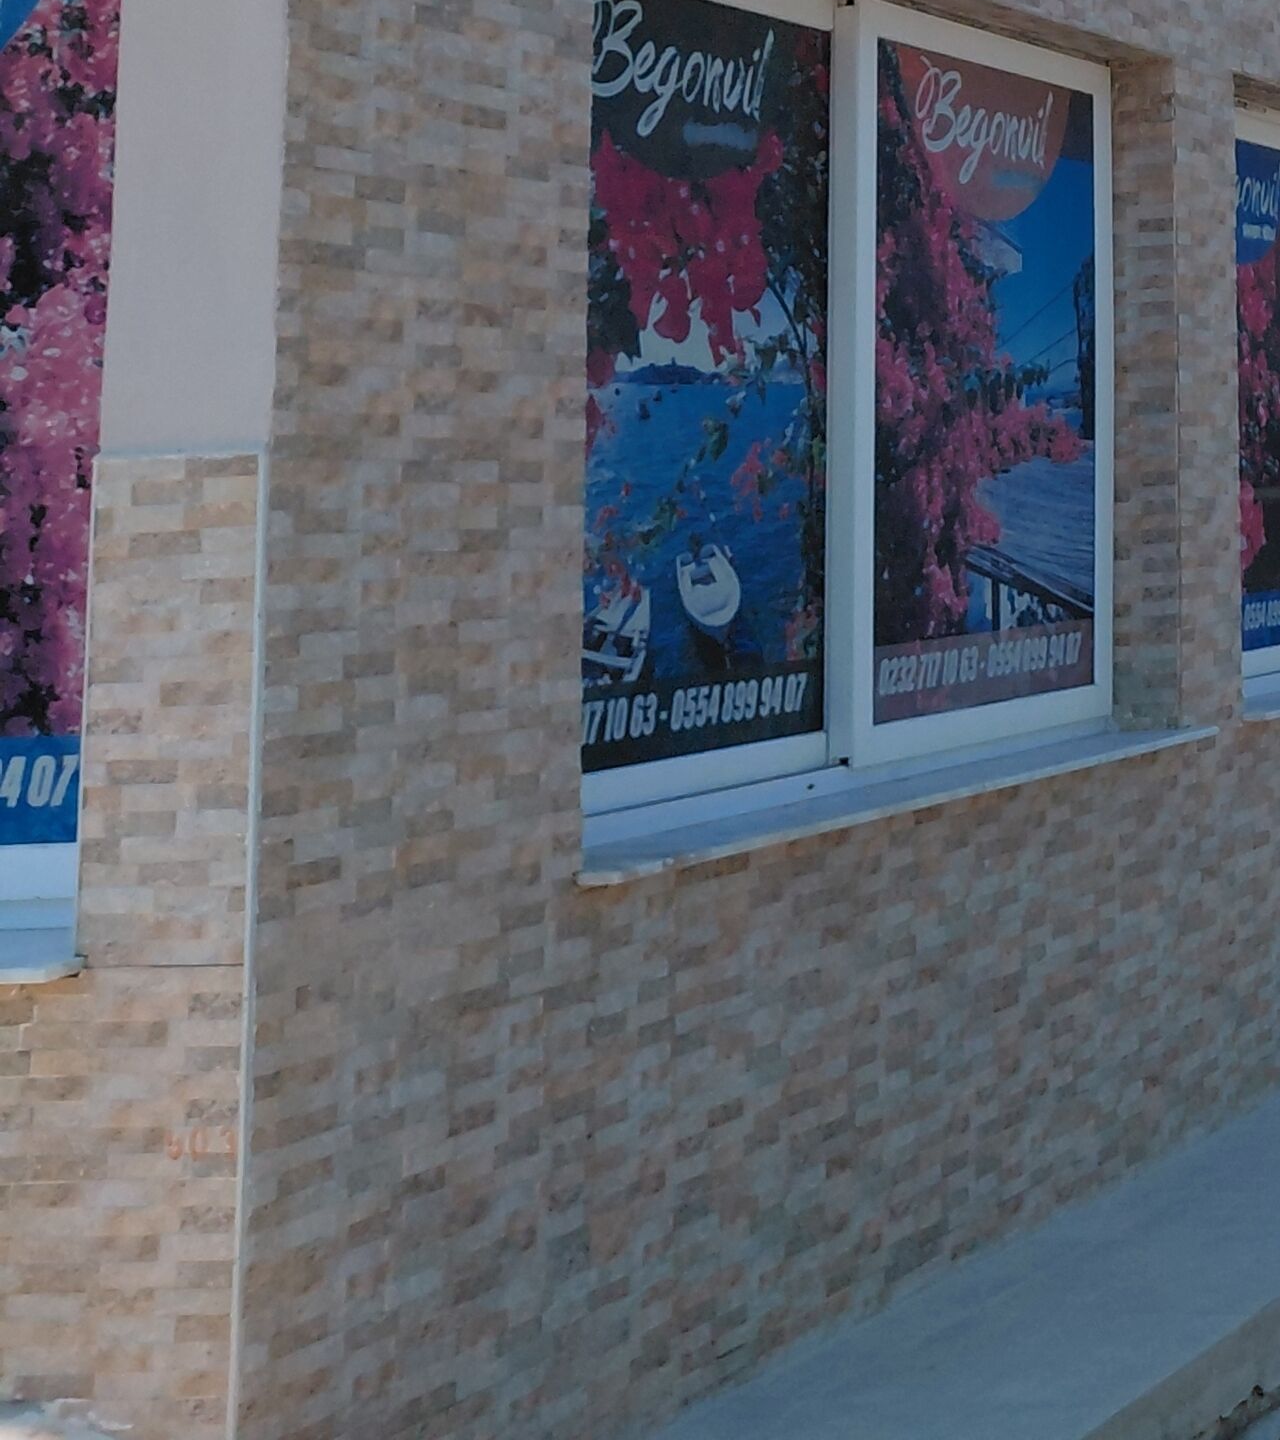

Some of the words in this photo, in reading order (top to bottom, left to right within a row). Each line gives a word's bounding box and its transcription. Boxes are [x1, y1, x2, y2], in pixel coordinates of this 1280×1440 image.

[915, 55, 1053, 185] Begonvil
[603, 696, 628, 742] 10
[629, 692, 658, 738] 63
[670, 684, 721, 732] 0554
[721, 679, 759, 723] 899
[759, 675, 784, 718] 94
[784, 672, 808, 712] 07
[0, 756, 27, 808] 4
[26, 754, 80, 807] 07
